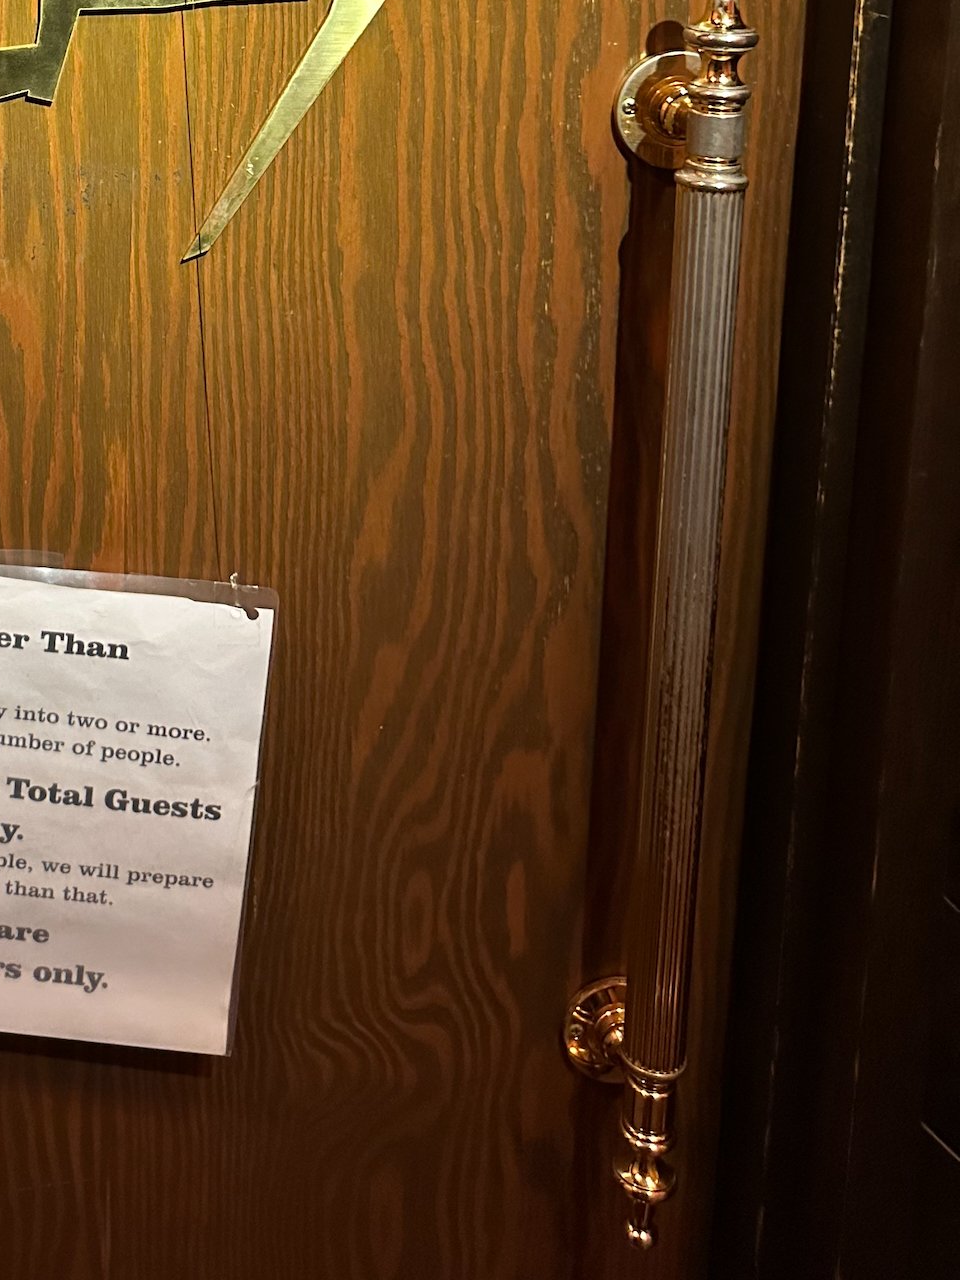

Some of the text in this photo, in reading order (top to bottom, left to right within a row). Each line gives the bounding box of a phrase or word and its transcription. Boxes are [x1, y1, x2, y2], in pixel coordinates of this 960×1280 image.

[40, 630, 130, 661] Than
[13, 704, 60, 725] into
[66, 710, 109, 731] two
[114, 720, 141, 735] or
[145, 723, 211, 742] more.
[71, 739, 97, 757] of
[99, 745, 181, 768] people.
[5, 776, 95, 809] Total
[103, 788, 222, 822] Guests
[41, 860, 72, 875] we
[78, 862, 120, 881] will
[125, 870, 215, 890] prepare
[4, 879, 55, 900] than
[62, 886, 113, 905] that.
[32, 964, 108, 994] only.
